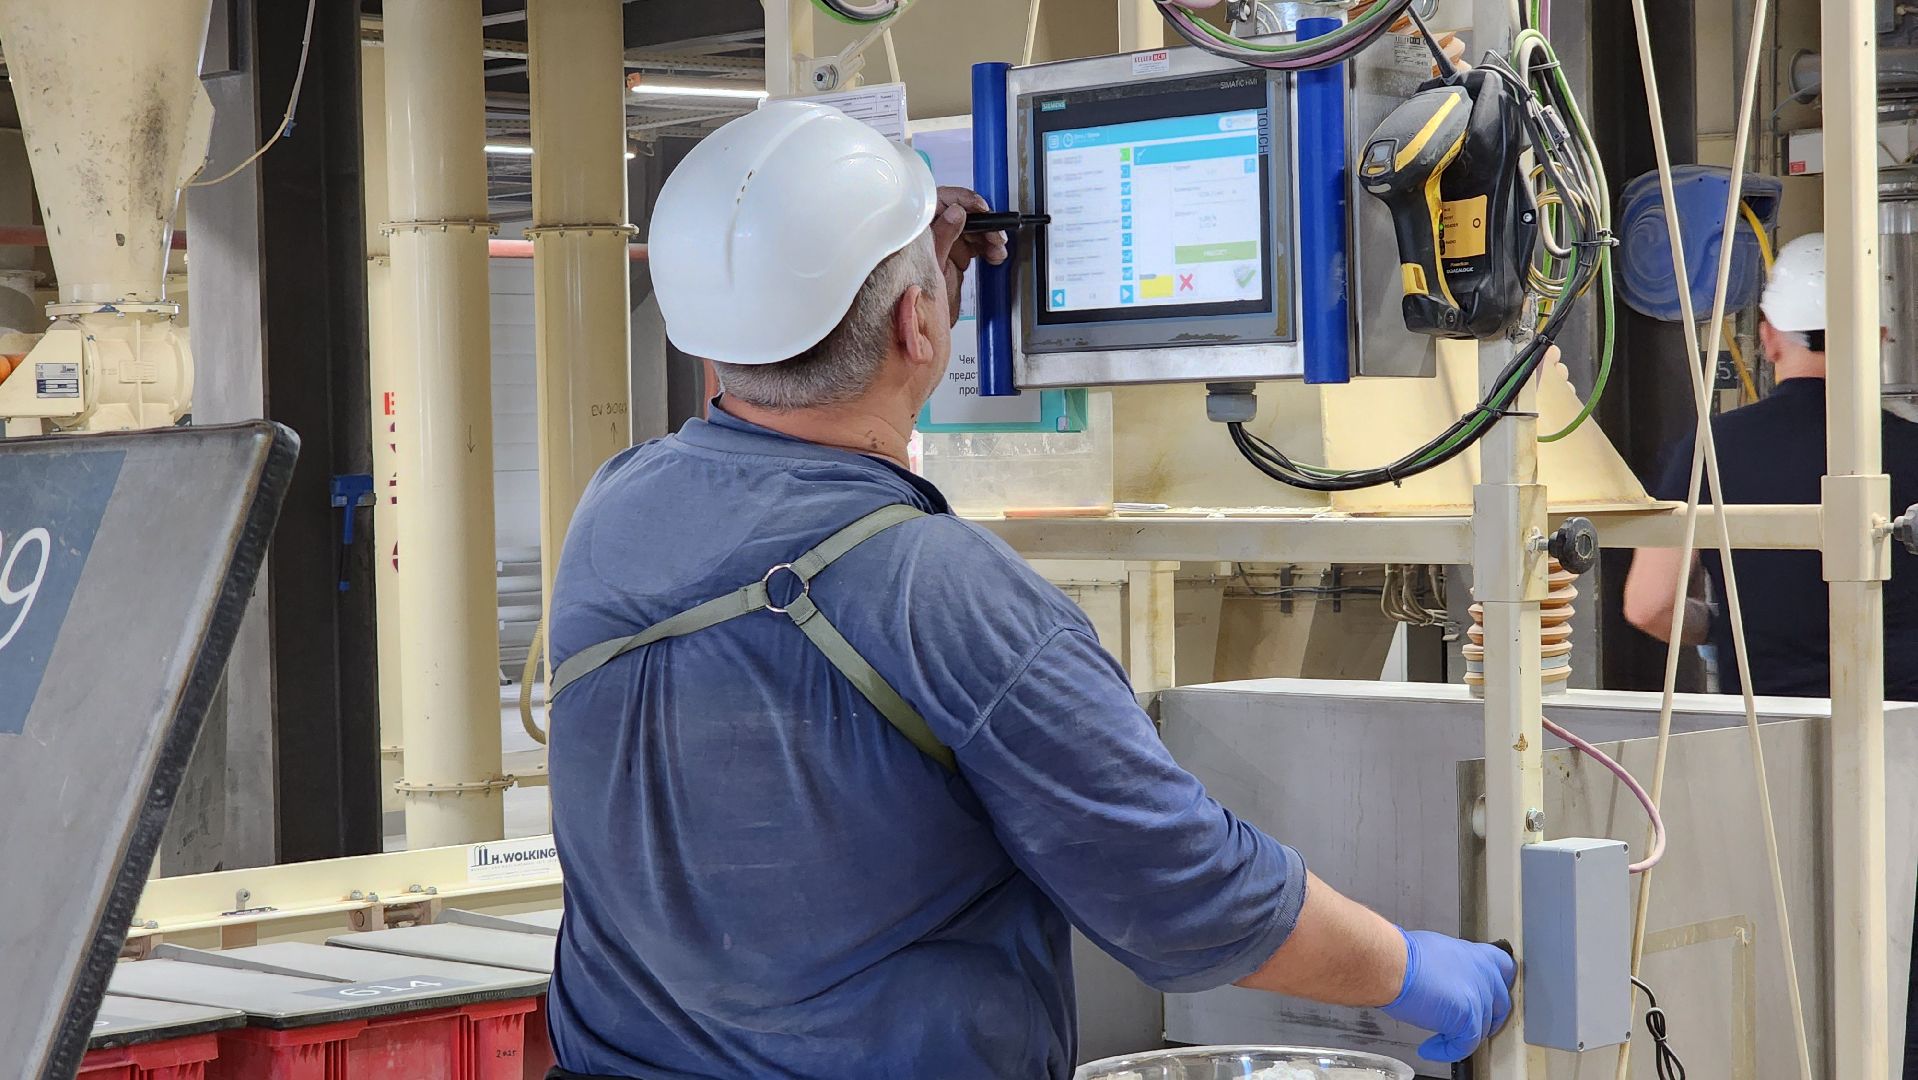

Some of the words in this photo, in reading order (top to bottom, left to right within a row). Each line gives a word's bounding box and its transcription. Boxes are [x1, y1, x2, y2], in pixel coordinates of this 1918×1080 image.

[1220, 79, 1245, 89] SIMATIC
[1245, 78, 1258, 86] HMI
[1258, 108, 1269, 154] TOUCH
[959, 354, 976, 364] Чек
[949, 371, 978, 382] предс
[0, 527, 51, 650] 9
[339, 979, 443, 998] 614
